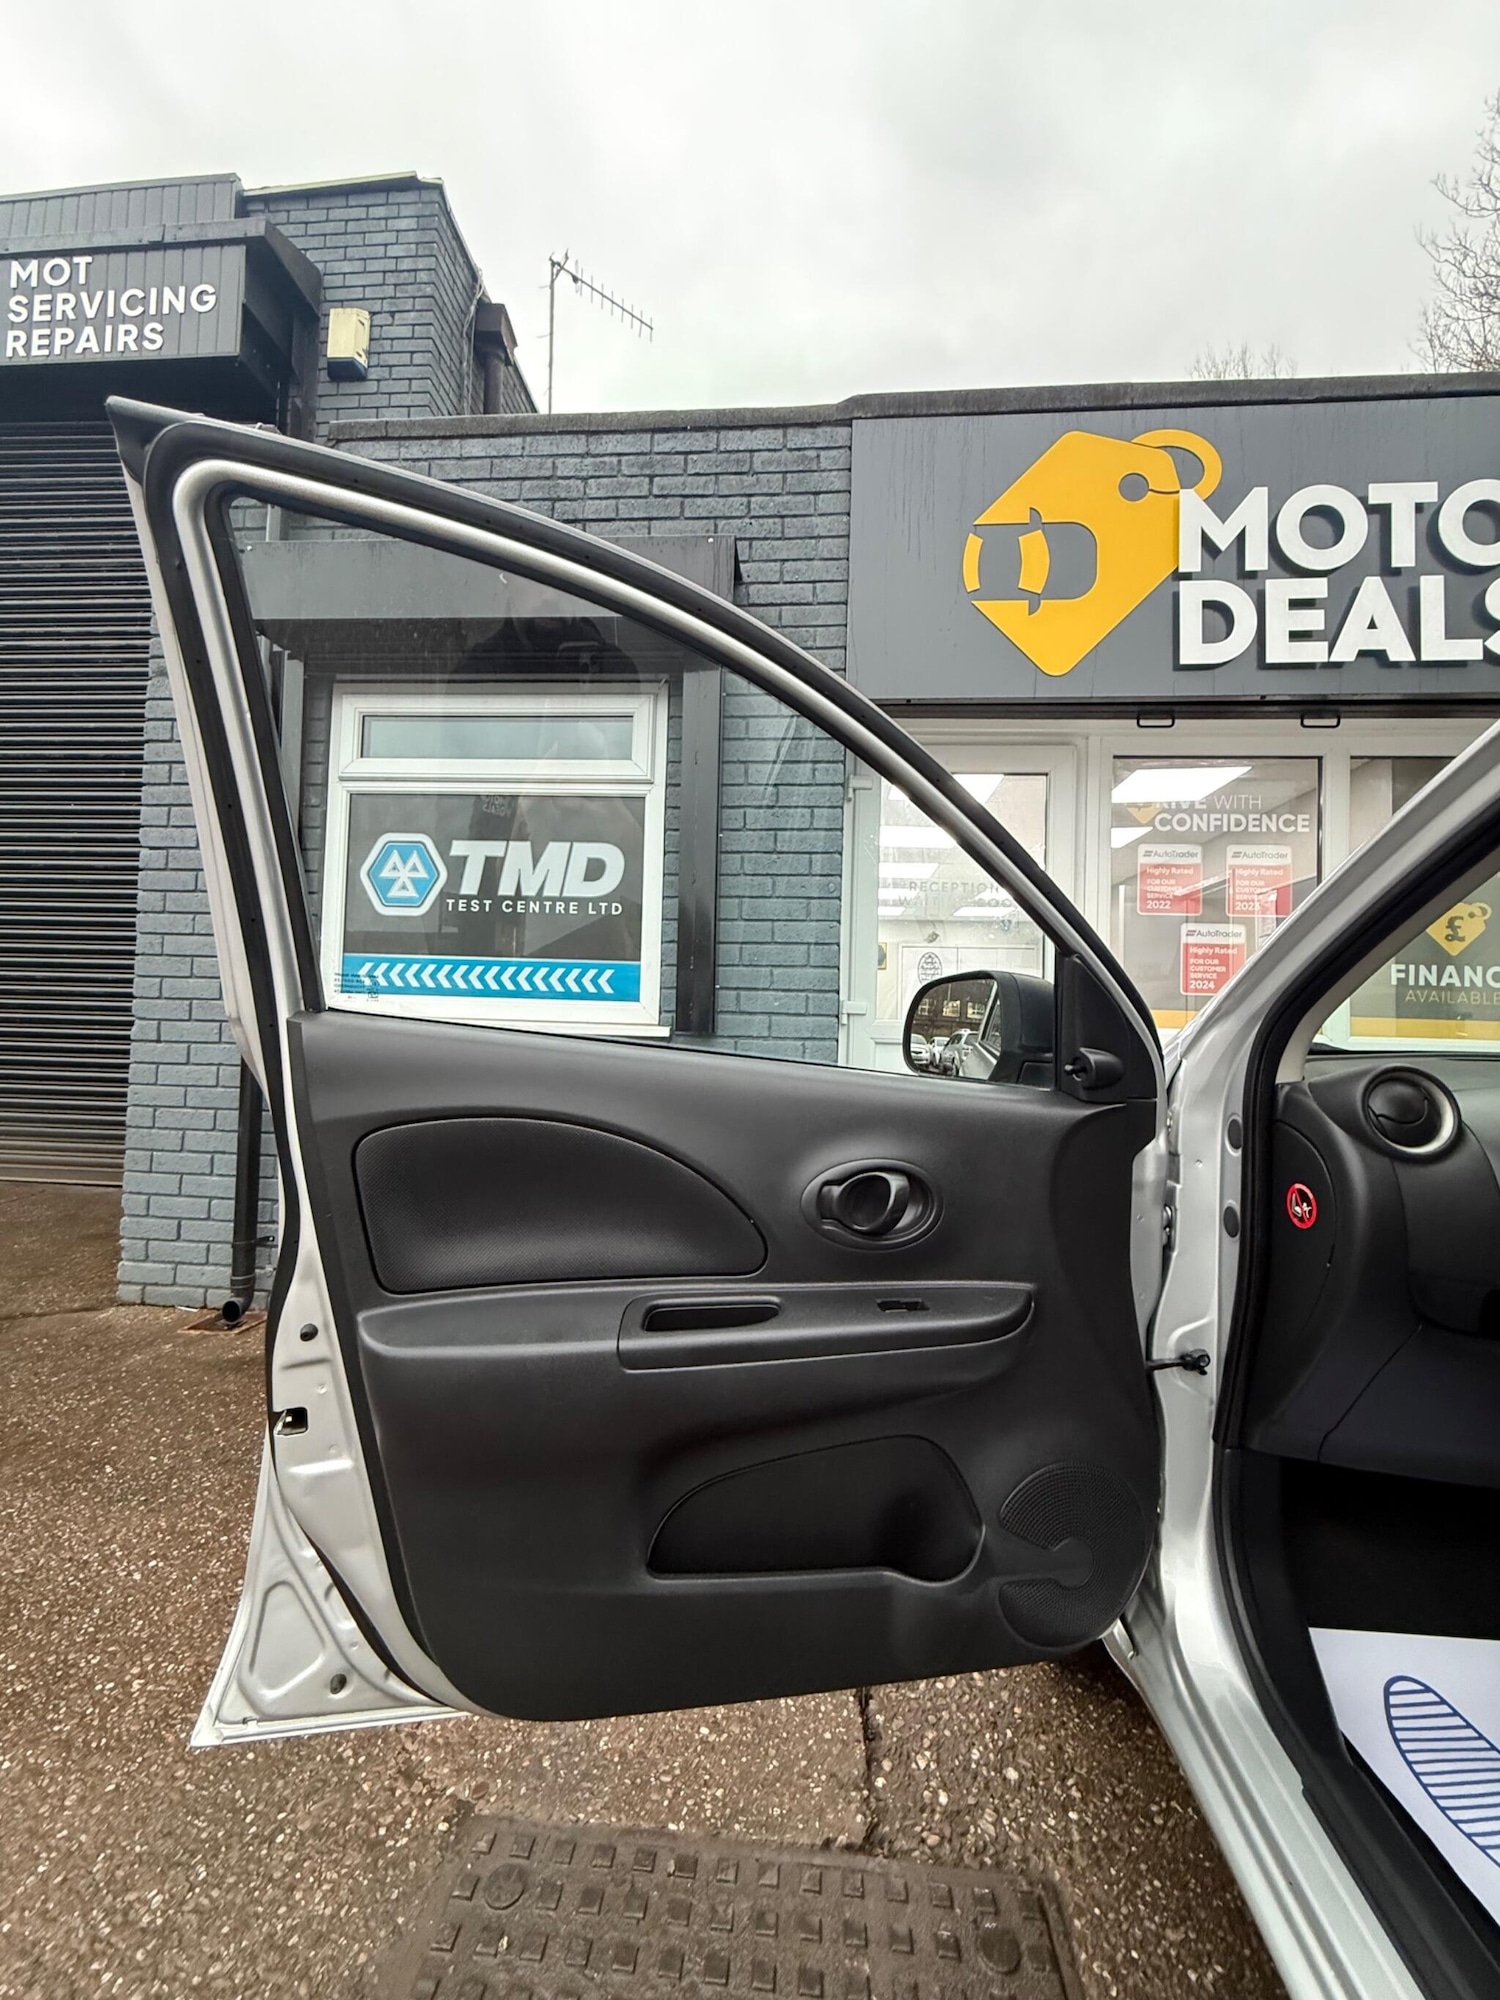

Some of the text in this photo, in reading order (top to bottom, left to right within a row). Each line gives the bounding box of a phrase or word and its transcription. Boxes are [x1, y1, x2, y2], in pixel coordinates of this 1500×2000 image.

[10, 256, 93, 289] MOT
[7, 283, 217, 324] SERVICING
[6, 321, 165, 359] REPAIRS
[1178, 478, 1500, 573] MOTO
[1179, 575, 1500, 665] DEAL
[1214, 795, 1262, 809] WITH
[1154, 813, 1311, 832] CONFIDENCE
[1153, 850, 1199, 859] AutoTrader
[1241, 851, 1289, 860] AutoTrader
[449, 840, 625, 898] TMD
[1146, 867, 1194, 876] Highly Rated
[1235, 868, 1259, 877] Highly
[446, 899, 623, 915] TEST CENTRE LTD
[1146, 900, 1172, 909] 2022
[1196, 929, 1242, 938] AutoTrader
[1189, 946, 1214, 955] Highly
[1189, 965, 1226, 973] CUSTOMER
[1390, 963, 1500, 988] FINANC
[1189, 980, 1216, 990] 2024
